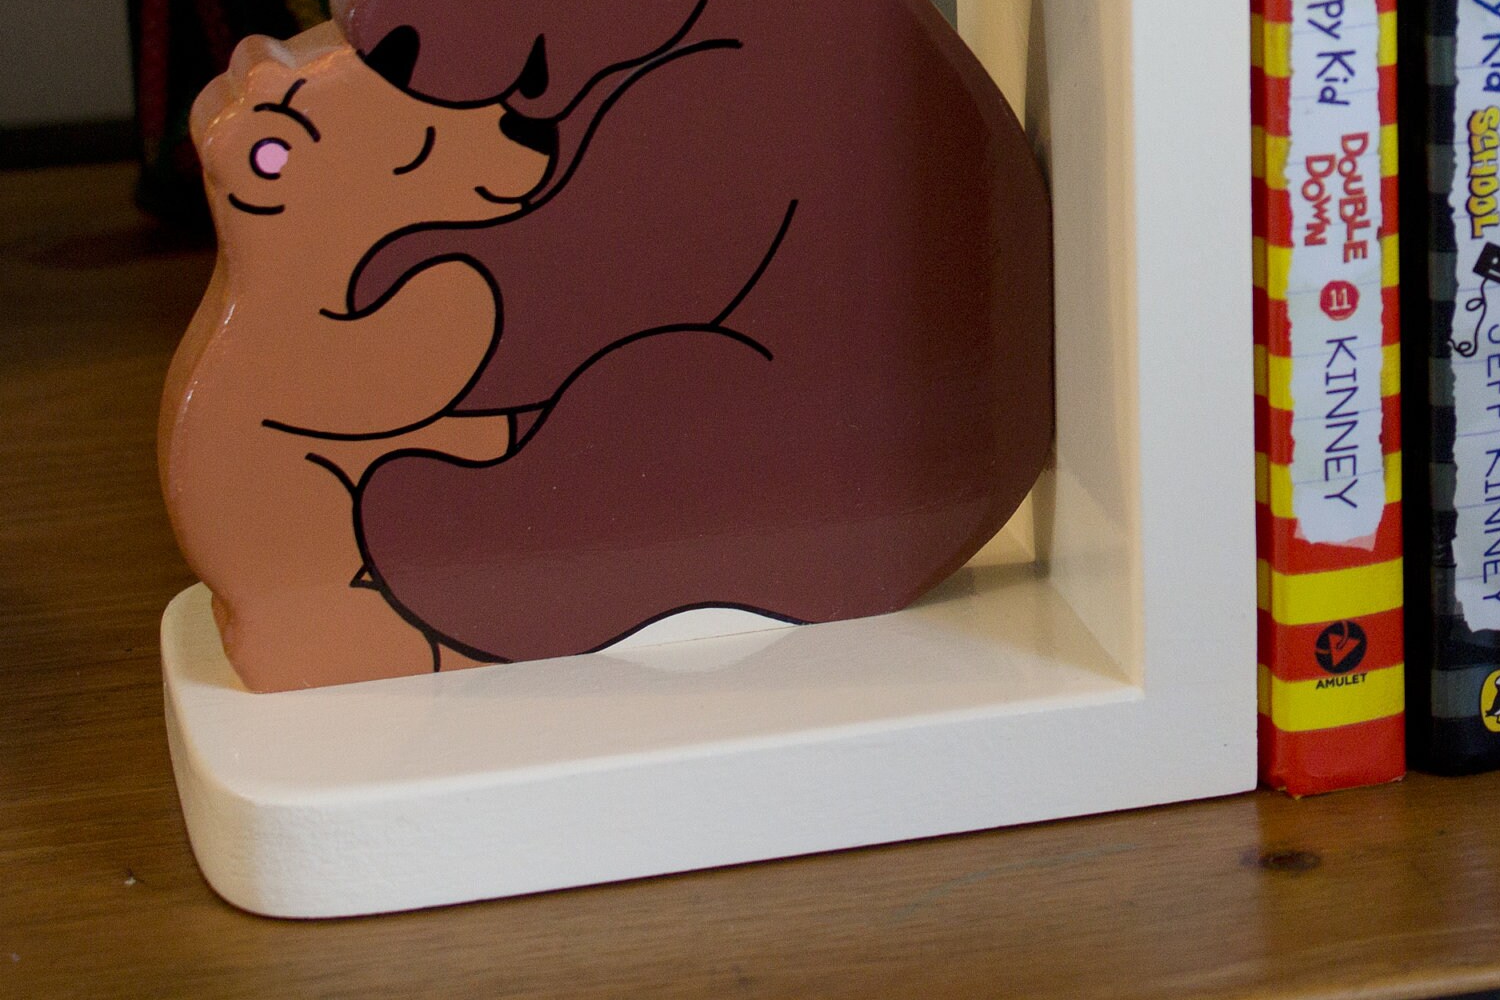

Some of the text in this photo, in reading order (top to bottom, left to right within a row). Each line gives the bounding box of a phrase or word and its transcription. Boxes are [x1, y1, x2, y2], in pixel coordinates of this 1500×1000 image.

[1316, 50, 1356, 106] Kid
[1301, 153, 1336, 247] DOWN
[1337, 131, 1372, 264] DOUBLE
[1328, 289, 1350, 311] 11
[1324, 335, 1359, 509] KINNEY
[1315, 672, 1368, 690] AMULET
